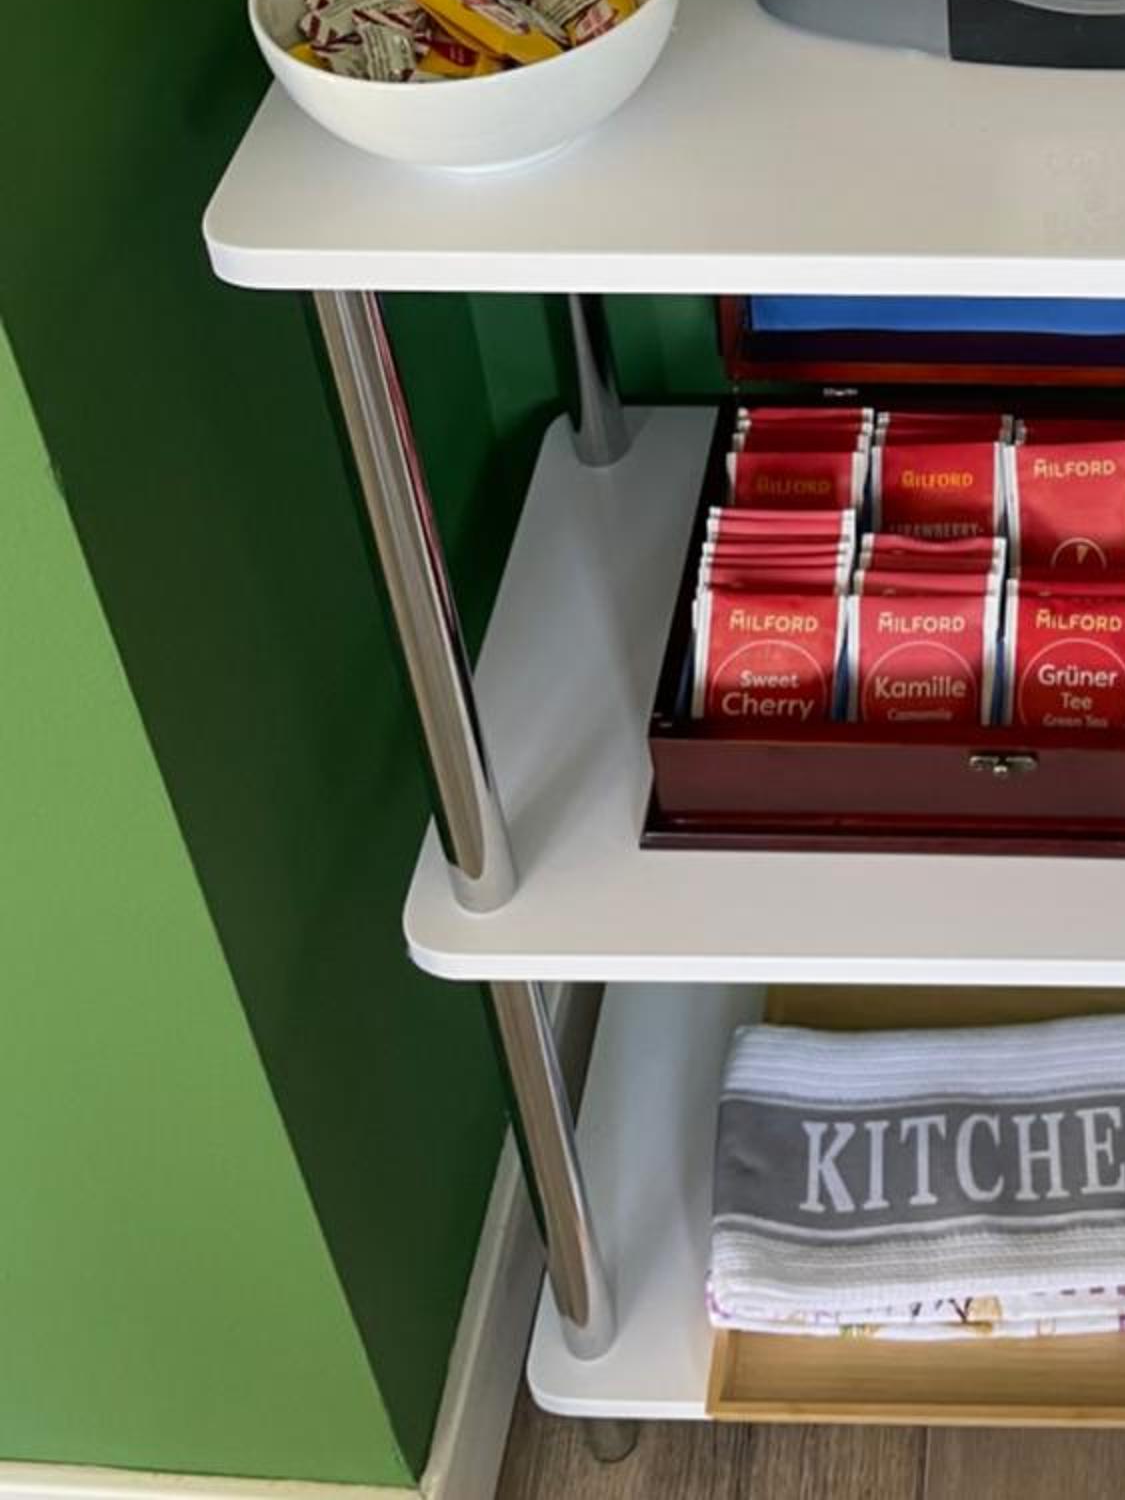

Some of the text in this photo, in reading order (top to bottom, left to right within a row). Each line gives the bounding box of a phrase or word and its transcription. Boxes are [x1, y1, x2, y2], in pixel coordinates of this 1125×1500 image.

[902, 469, 974, 488] MILFORD
[1033, 459, 1117, 478] MILFORD
[729, 609, 819, 633] MILFORD
[877, 611, 966, 634] MILFORD
[1035, 609, 1123, 632] MILFORD
[740, 670, 800, 689] Sweet
[875, 675, 967, 699] Kamille
[1037, 664, 1118, 688] Grüner
[721, 691, 814, 721] Cherry
[1060, 692, 1093, 711] Tee
